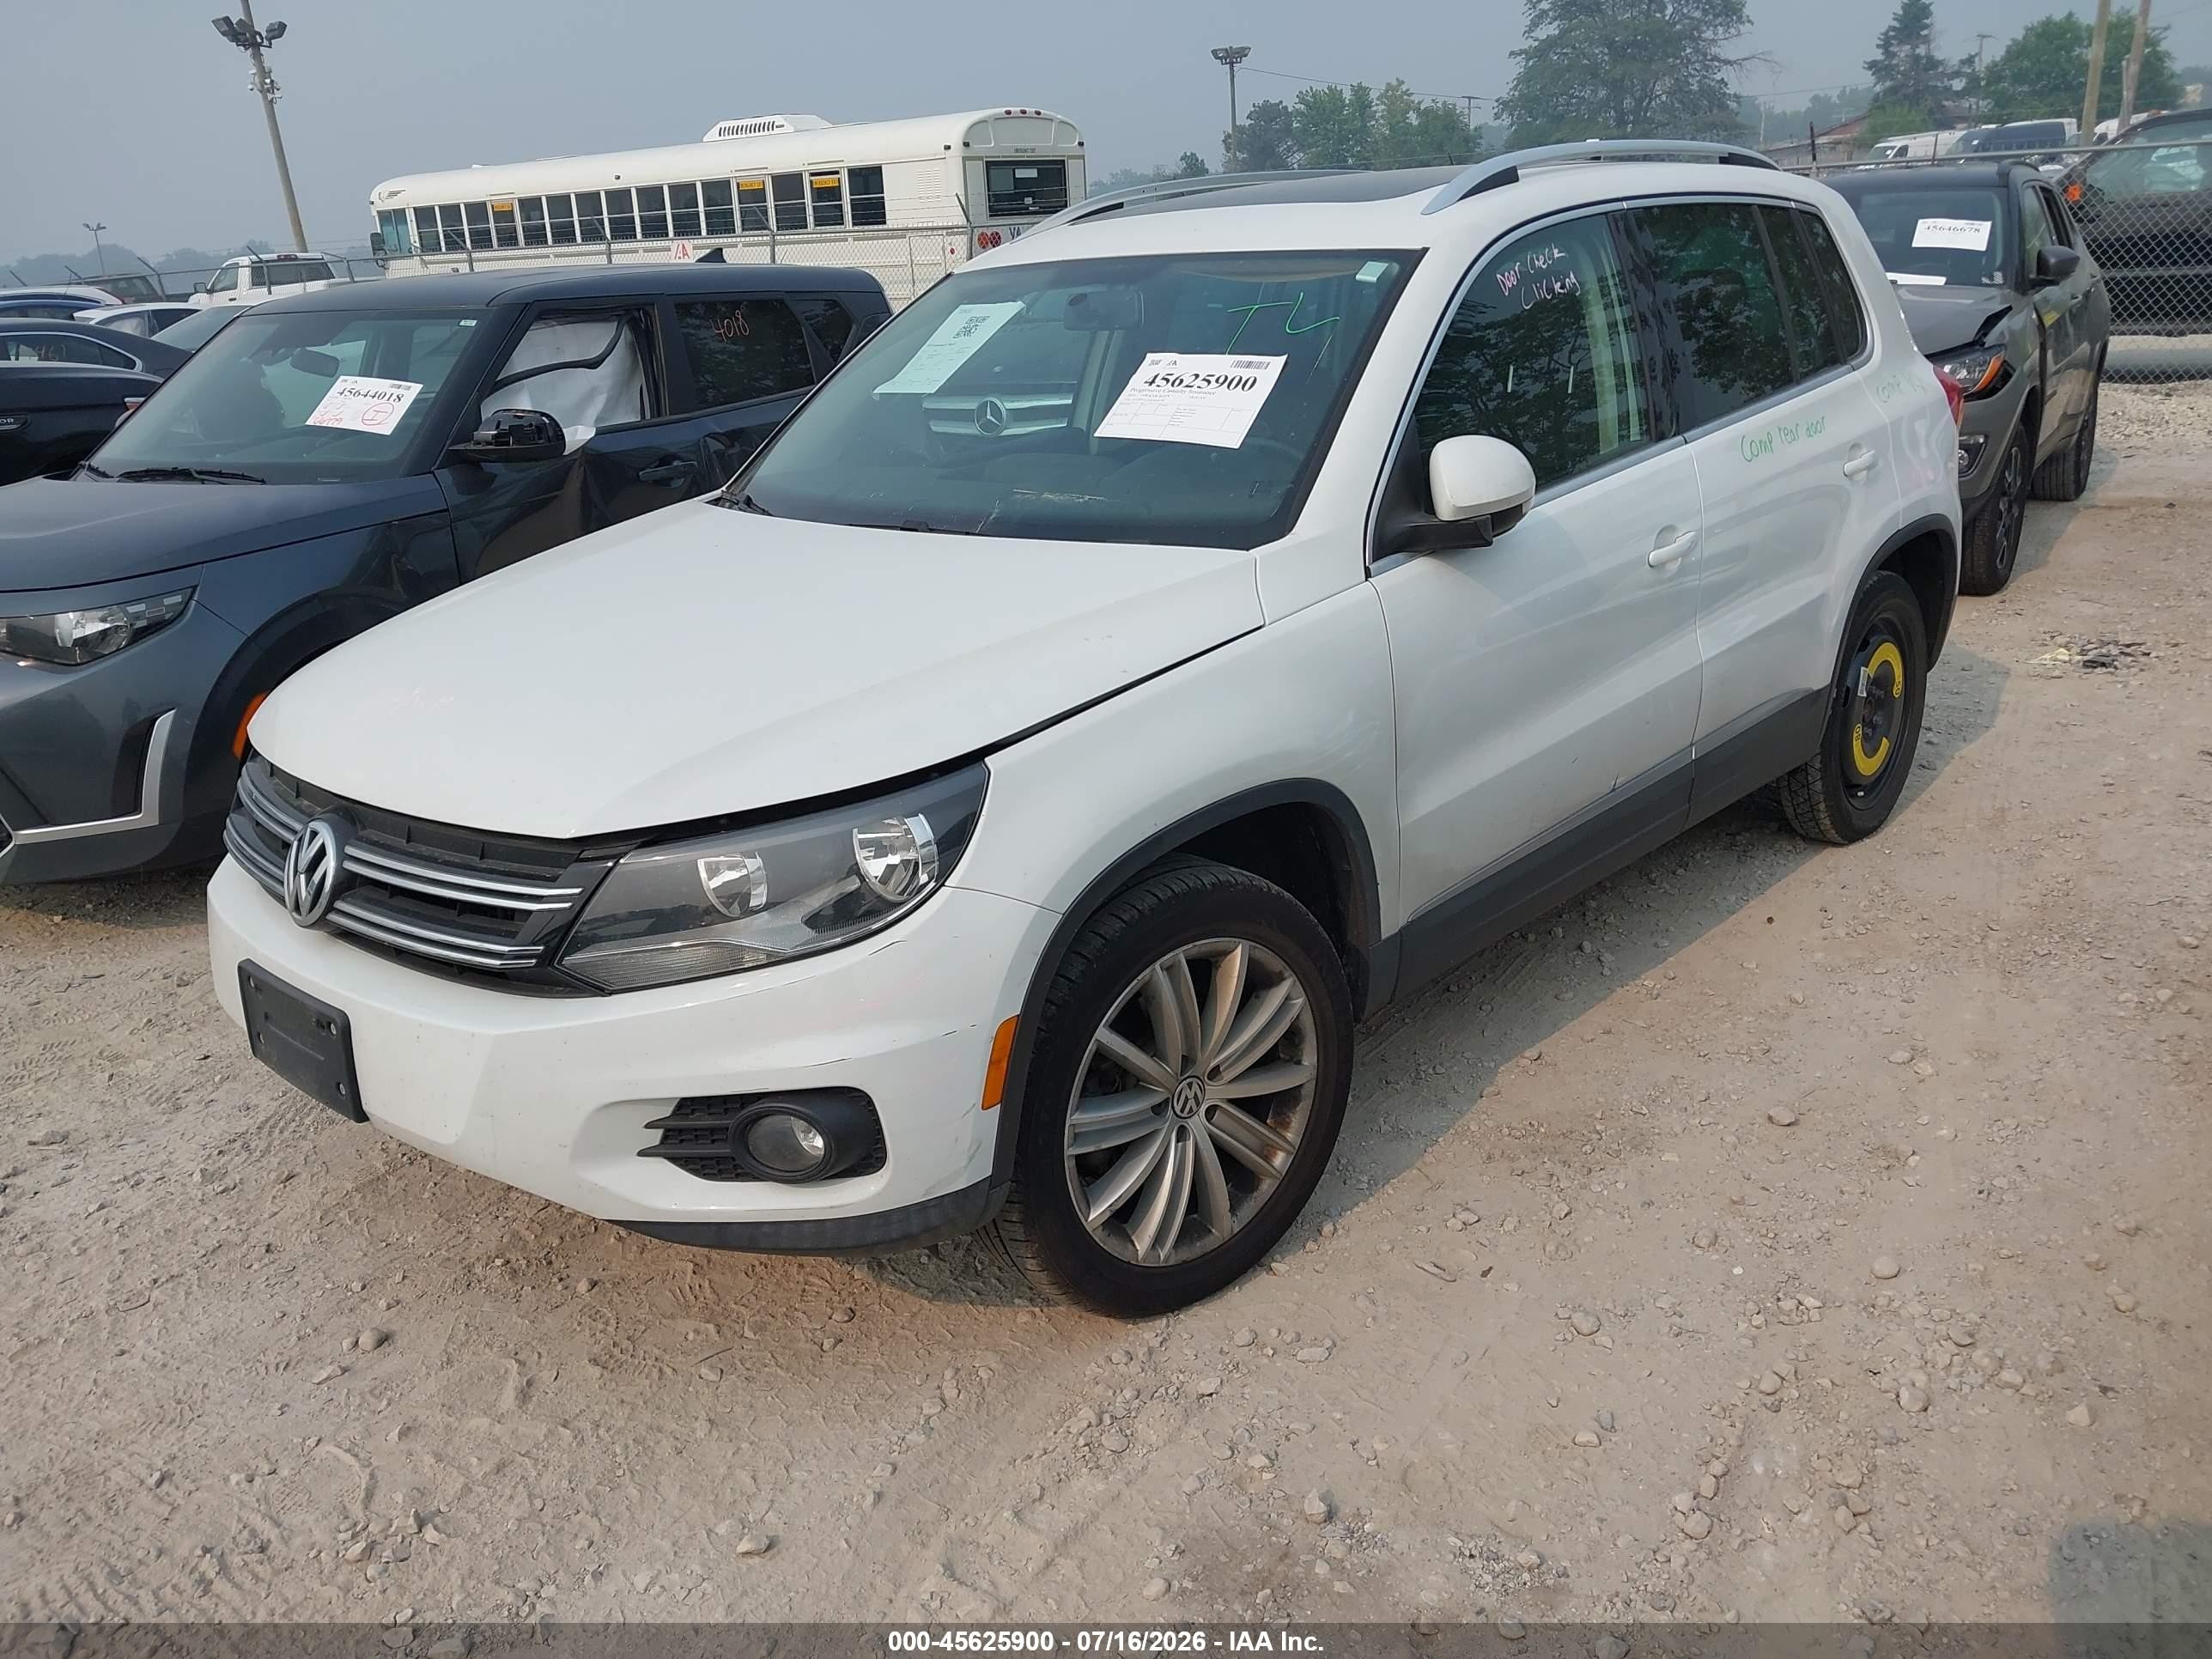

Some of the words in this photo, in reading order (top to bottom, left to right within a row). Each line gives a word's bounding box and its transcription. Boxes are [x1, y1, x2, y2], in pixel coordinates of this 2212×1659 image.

[1923, 225, 1981, 234] 45646678
[708, 309, 750, 343] 4018
[1144, 372, 1258, 392] 45625900
[337, 387, 405, 404] 45644018
